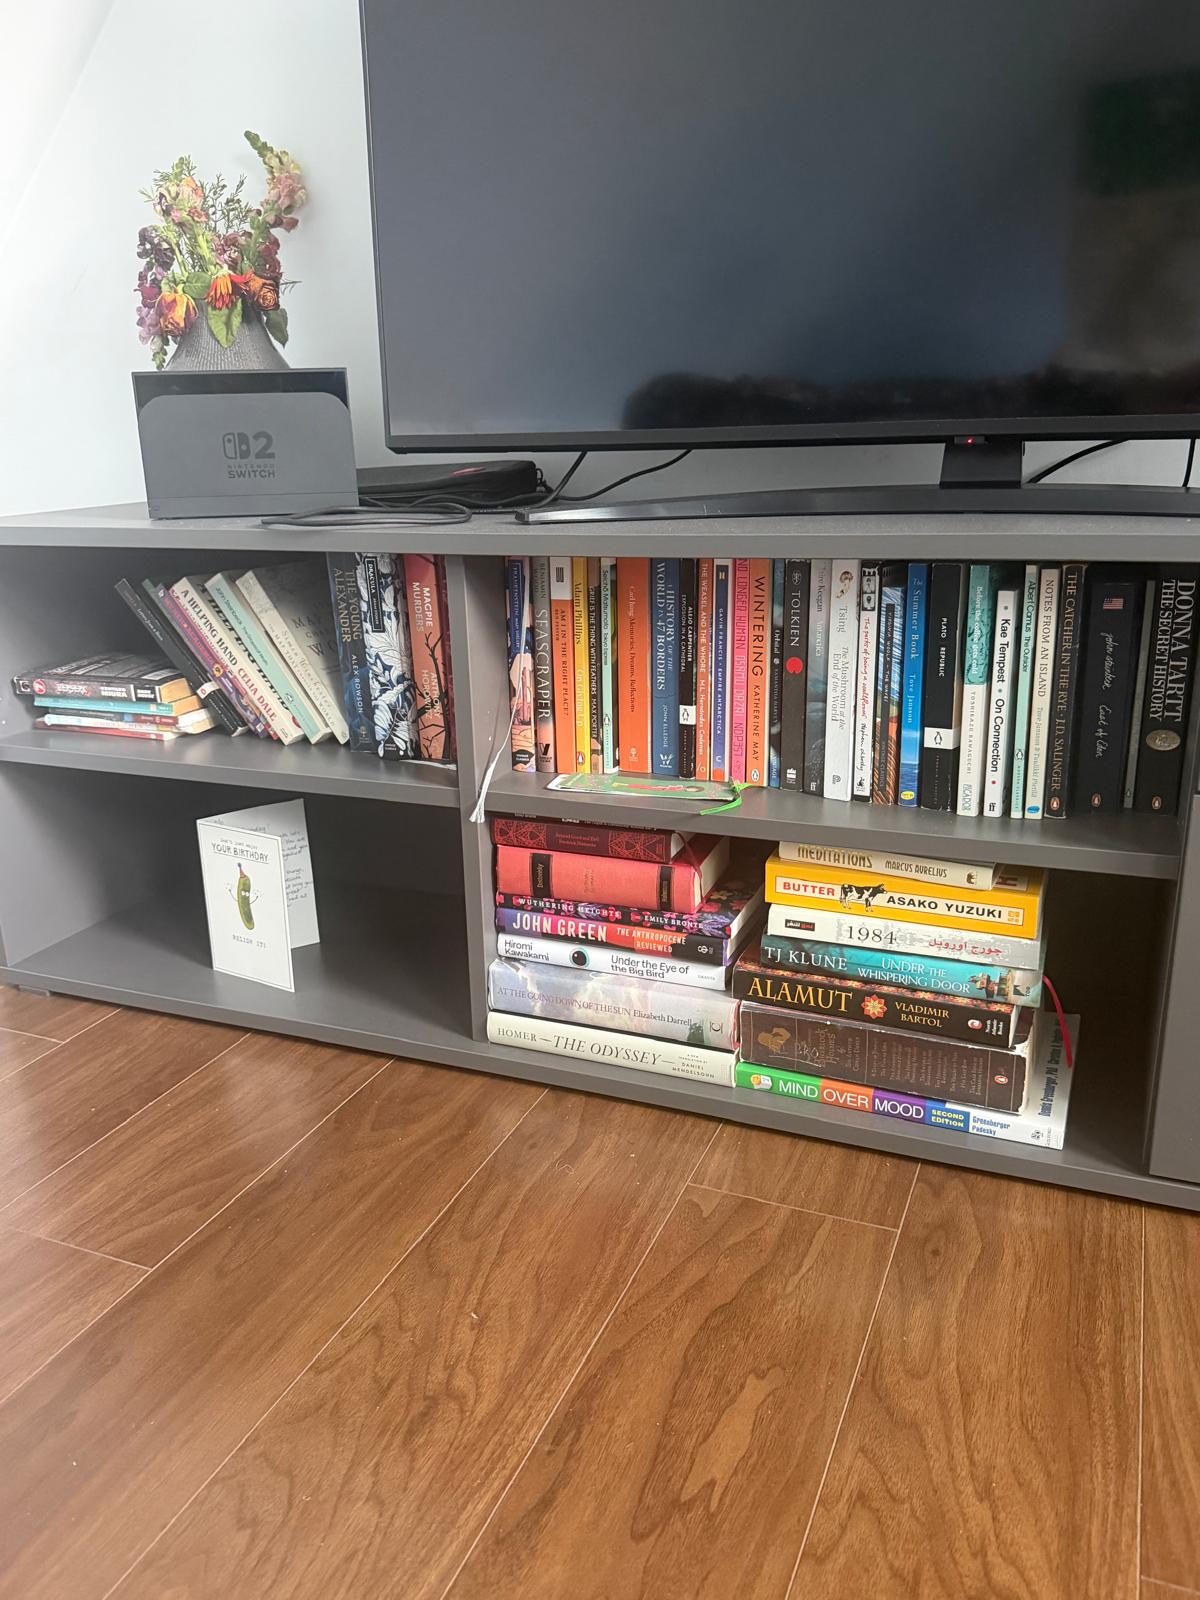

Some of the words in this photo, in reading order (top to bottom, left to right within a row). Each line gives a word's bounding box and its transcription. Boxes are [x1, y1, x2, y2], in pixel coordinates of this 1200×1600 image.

[227, 470, 276, 479] SWITCH
[345, 569, 356, 594] THE
[368, 563, 376, 593] DRACULA
[1066, 572, 1078, 596] THE
[975, 586, 983, 608] Before
[1026, 580, 1036, 604] Albert
[1160, 580, 1176, 609] THE
[334, 568, 350, 642] ALEXANDER
[412, 582, 424, 632] MURDERS
[422, 587, 433, 627] MAGPIE
[560, 609, 566, 620] AM
[1171, 580, 1196, 653] DONNA
[349, 597, 362, 640] YOUNG
[574, 610, 583, 645] Phillips
[752, 576, 765, 676] WINTERING
[790, 591, 801, 646] TOLKIEN
[837, 606, 847, 633] Tsing
[999, 618, 1011, 639] Kae
[1025, 605, 1035, 632] Camus
[1061, 598, 1075, 650] CATCHER
[560, 628, 567, 638] IN
[973, 622, 981, 642] coffee
[1100, 633, 1119, 654] john
[1155, 611, 1172, 662] SECRET
[181, 589, 189, 598] A
[188, 597, 218, 638] HELPING
[216, 638, 238, 666] HAND
[238, 668, 258, 696] CELIA
[257, 694, 278, 722] DALE
[938, 647, 946, 677] REPUBLIC
[971, 644, 979, 658] gets
[996, 641, 1010, 683] Tempest
[1022, 648, 1031, 672] Outsider
[1061, 652, 1071, 665] IN
[351, 654, 360, 675] ALEX
[535, 609, 550, 718] SEASCRAPER
[971, 660, 979, 675] cold
[1103, 655, 1117, 690] steinbeck
[832, 682, 840, 693] the
[840, 660, 849, 709] Mushroom
[1058, 667, 1070, 689] THE
[1163, 657, 1188, 722] TARTT
[353, 678, 364, 713] ROWSON
[422, 669, 433, 719] HOROWITZ
[430, 672, 441, 719] ANTHONY
[1057, 691, 1068, 712] RYE
[1149, 665, 1166, 722] HISTORY
[831, 695, 840, 722] World
[995, 698, 1004, 714] On
[839, 719, 847, 730] the
[1055, 718, 1066, 736] J.D.
[752, 742, 760, 761] MAY
[990, 716, 1004, 773] Connection
[1051, 738, 1064, 790] SALINGER
[211, 842, 231, 854] YOUR
[234, 846, 269, 863] BIRTHDAY
[798, 846, 872, 869] MEDITATIONS
[884, 860, 913, 874] MARCUS
[914, 863, 948, 878] AURELIUS
[782, 881, 836, 898] BUTTER
[886, 895, 938, 911] ASAKO
[944, 902, 1002, 919] YUZUKI
[512, 912, 552, 934] JOHN
[557, 918, 607, 943] GREEN
[617, 927, 630, 938] THE
[631, 929, 687, 945] ANTHROPOCENE
[848, 925, 898, 945] 1984
[504, 939, 533, 950] Hiromi
[504, 948, 550, 962] Kawakami
[636, 940, 673, 953] REVIEWED
[970, 944, 1002, 956] جورج
[611, 954, 641, 968] Under
[642, 958, 658, 969] the
[659, 961, 676, 975] Eye
[678, 963, 690, 975] of
[764, 946, 782, 963] TJ
[788, 949, 848, 970] KLUNE
[881, 958, 925, 974] UNDER
[928, 967, 947, 978] THE
[611, 964, 627, 973] the
[628, 965, 643, 979] Big
[645, 968, 665, 979] Bird
[857, 968, 928, 988] WHISPERING
[931, 978, 970, 993] DOOR
[497, 986, 510, 995] AT
[510, 988, 527, 999] THE
[527, 990, 554, 1002] GOING
[554, 995, 581, 1007] DOWN
[581, 1000, 594, 1010] OF
[594, 1001, 612, 1012] THE
[613, 1004, 630, 1016] SUN
[633, 1008, 665, 1021] Elizabeth
[666, 1012, 692, 1027] Darrell
[747, 978, 853, 1013] ALAMUT
[894, 1002, 950, 1020] VLADIMIR
[900, 1013, 943, 1028] BARTOL
[498, 1027, 537, 1042] HOMER
[552, 1034, 585, 1053] THE
[590, 1041, 663, 1066] ODYSSEY
[672, 1066, 715, 1079] MENDELSOHN
[681, 1062, 704, 1070] DANIEL
[778, 1080, 818, 1098] MIND
[823, 1089, 869, 1108] OVER
[875, 1097, 924, 1119] MOOD
[931, 1109, 965, 1120] SECOND
[931, 1116, 964, 1128] EDITION
[972, 1116, 1011, 1130] Greenberger
[972, 1125, 997, 1136] Padesky
